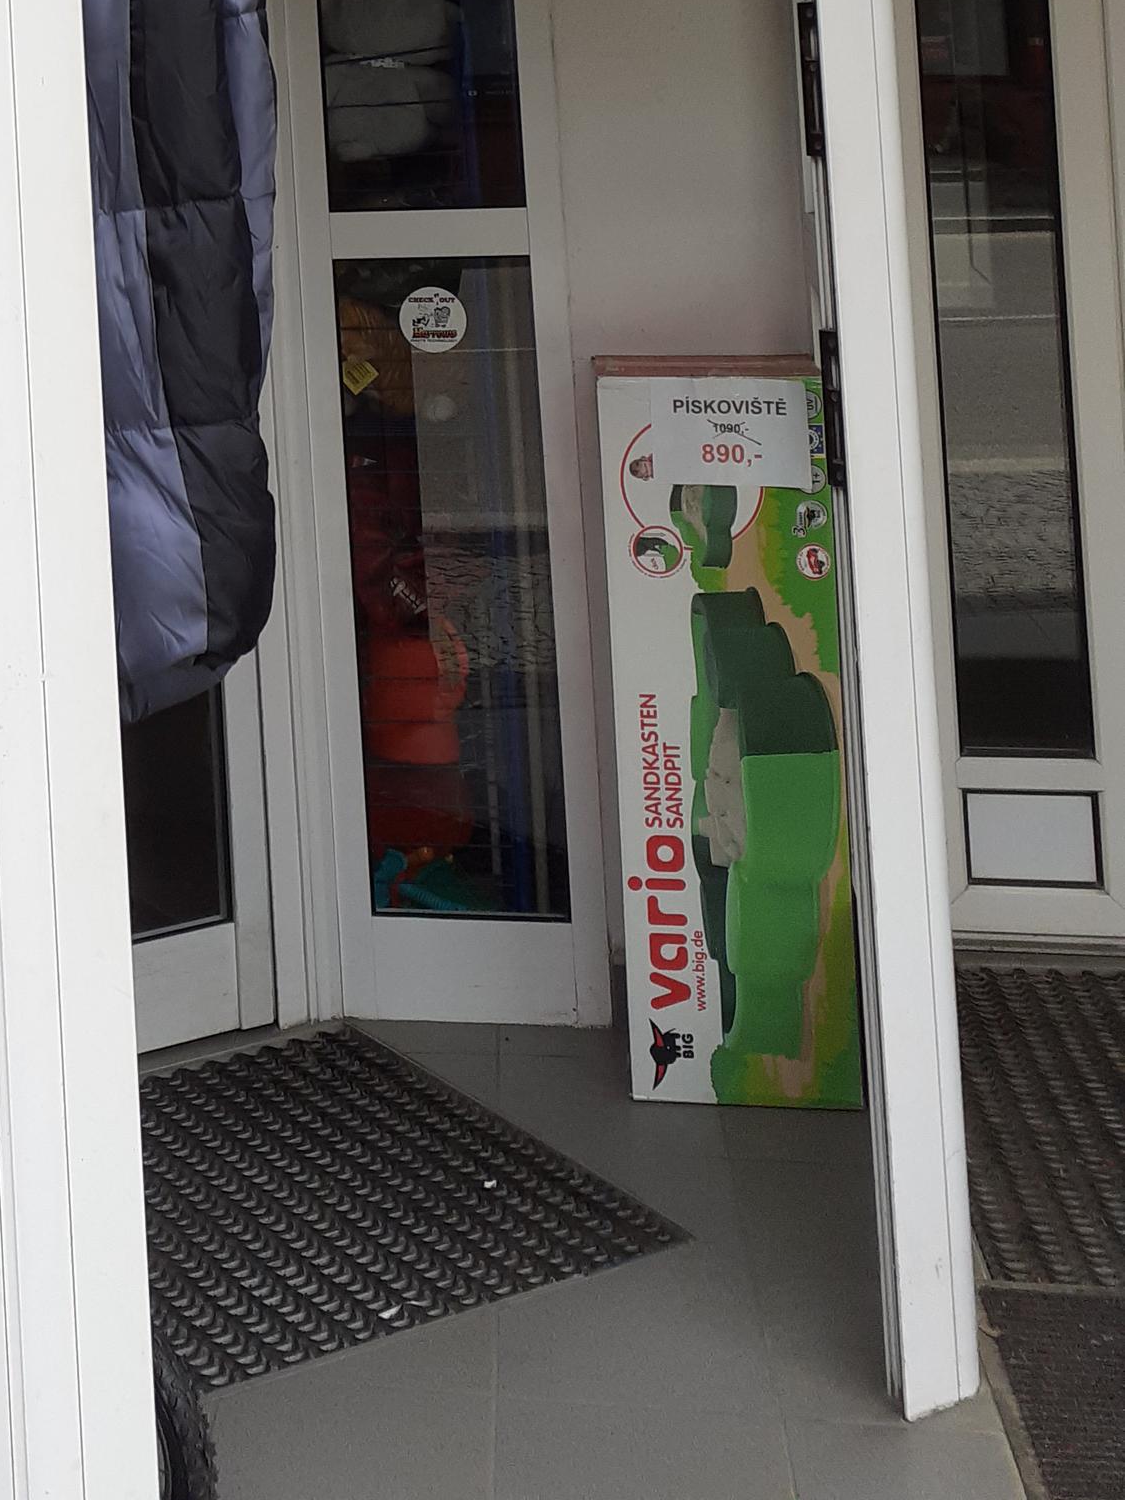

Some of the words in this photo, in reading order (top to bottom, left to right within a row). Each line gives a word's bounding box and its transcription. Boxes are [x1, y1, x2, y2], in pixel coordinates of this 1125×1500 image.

[673, 396, 787, 416] PÍSKOVIŠTĚ
[702, 444, 762, 466] 890,-
[639, 694, 663, 827] SANDKASTEN
[663, 743, 683, 829] SANDPIT
[628, 835, 692, 1010] vario
[693, 930, 706, 1011] www.big.de
[682, 1033, 694, 1059] BIG
